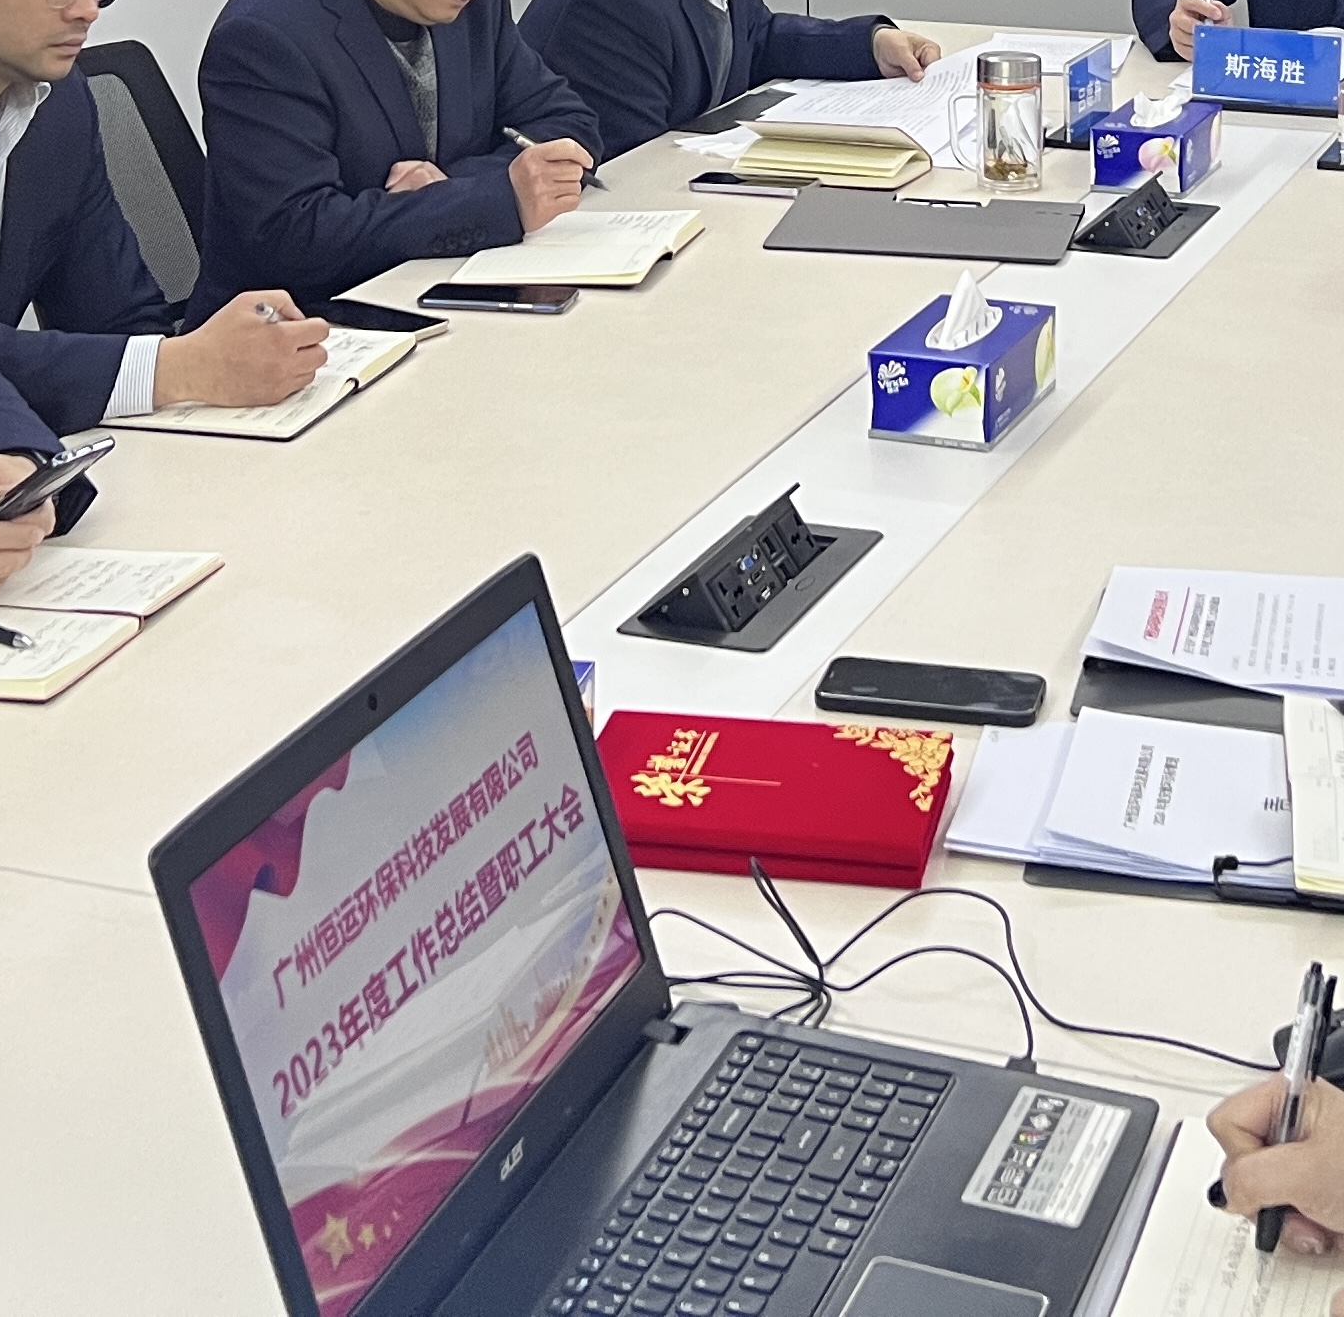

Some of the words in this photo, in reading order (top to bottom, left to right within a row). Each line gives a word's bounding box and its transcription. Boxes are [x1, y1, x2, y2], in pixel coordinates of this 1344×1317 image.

[1224, 53, 1306, 85] 斯海胜
[271, 730, 539, 1009] 广州恒运环保科技发展有限公司
[271, 783, 584, 1119] 2023年度工作总结暨职工大会
